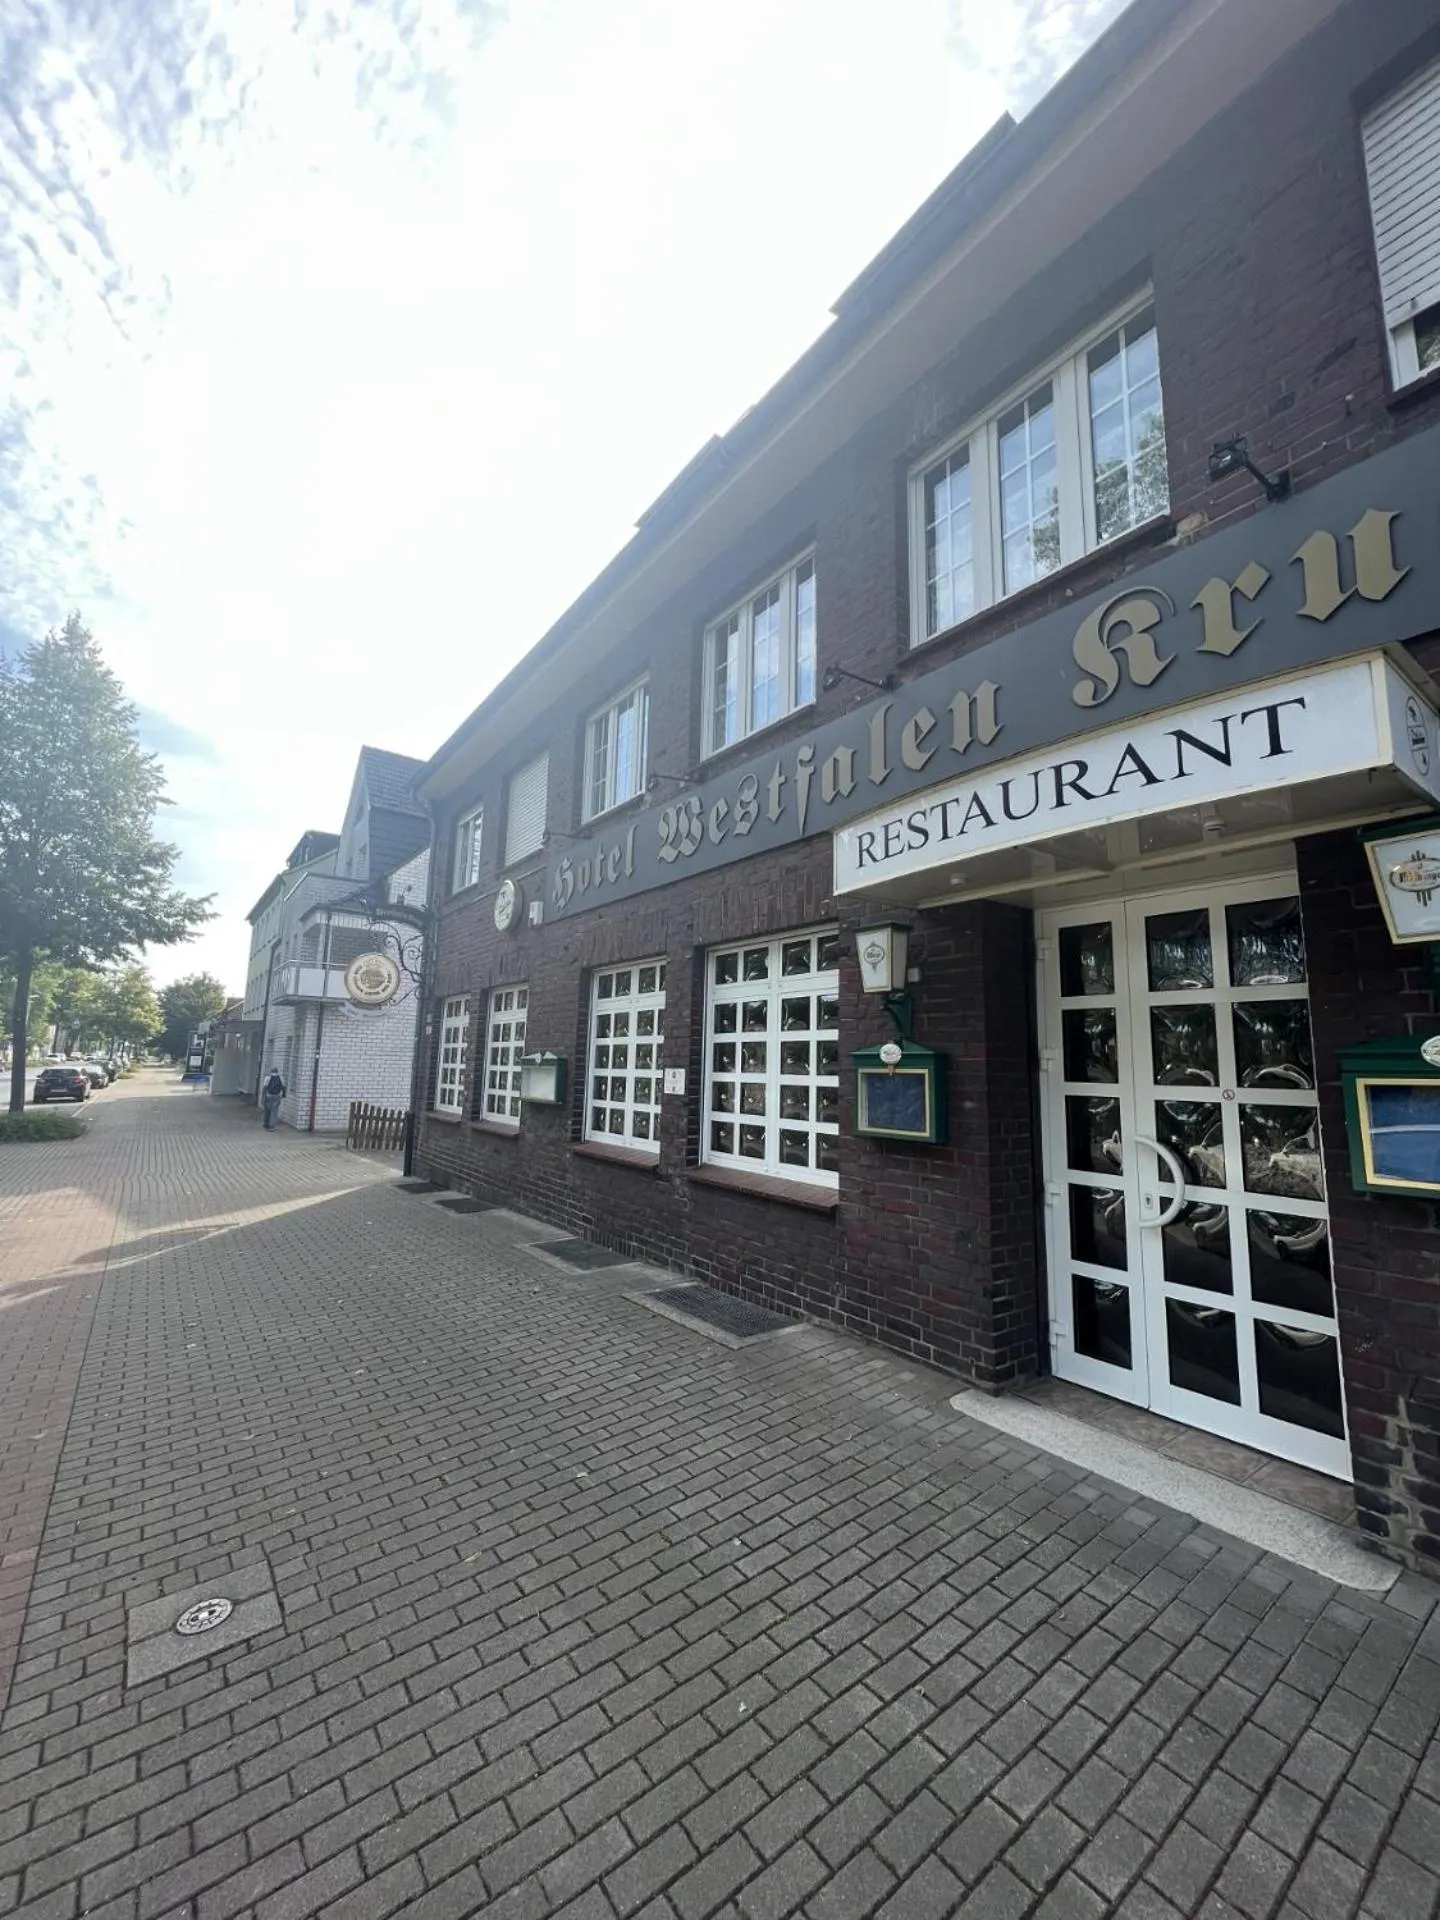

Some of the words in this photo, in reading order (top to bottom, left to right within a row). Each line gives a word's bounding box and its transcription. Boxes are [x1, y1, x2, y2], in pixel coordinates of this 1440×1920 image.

[552, 824, 638, 909] Hotel
[657, 679, 1003, 863] Westfalen
[855, 697, 1306, 868] RESTAURANT
